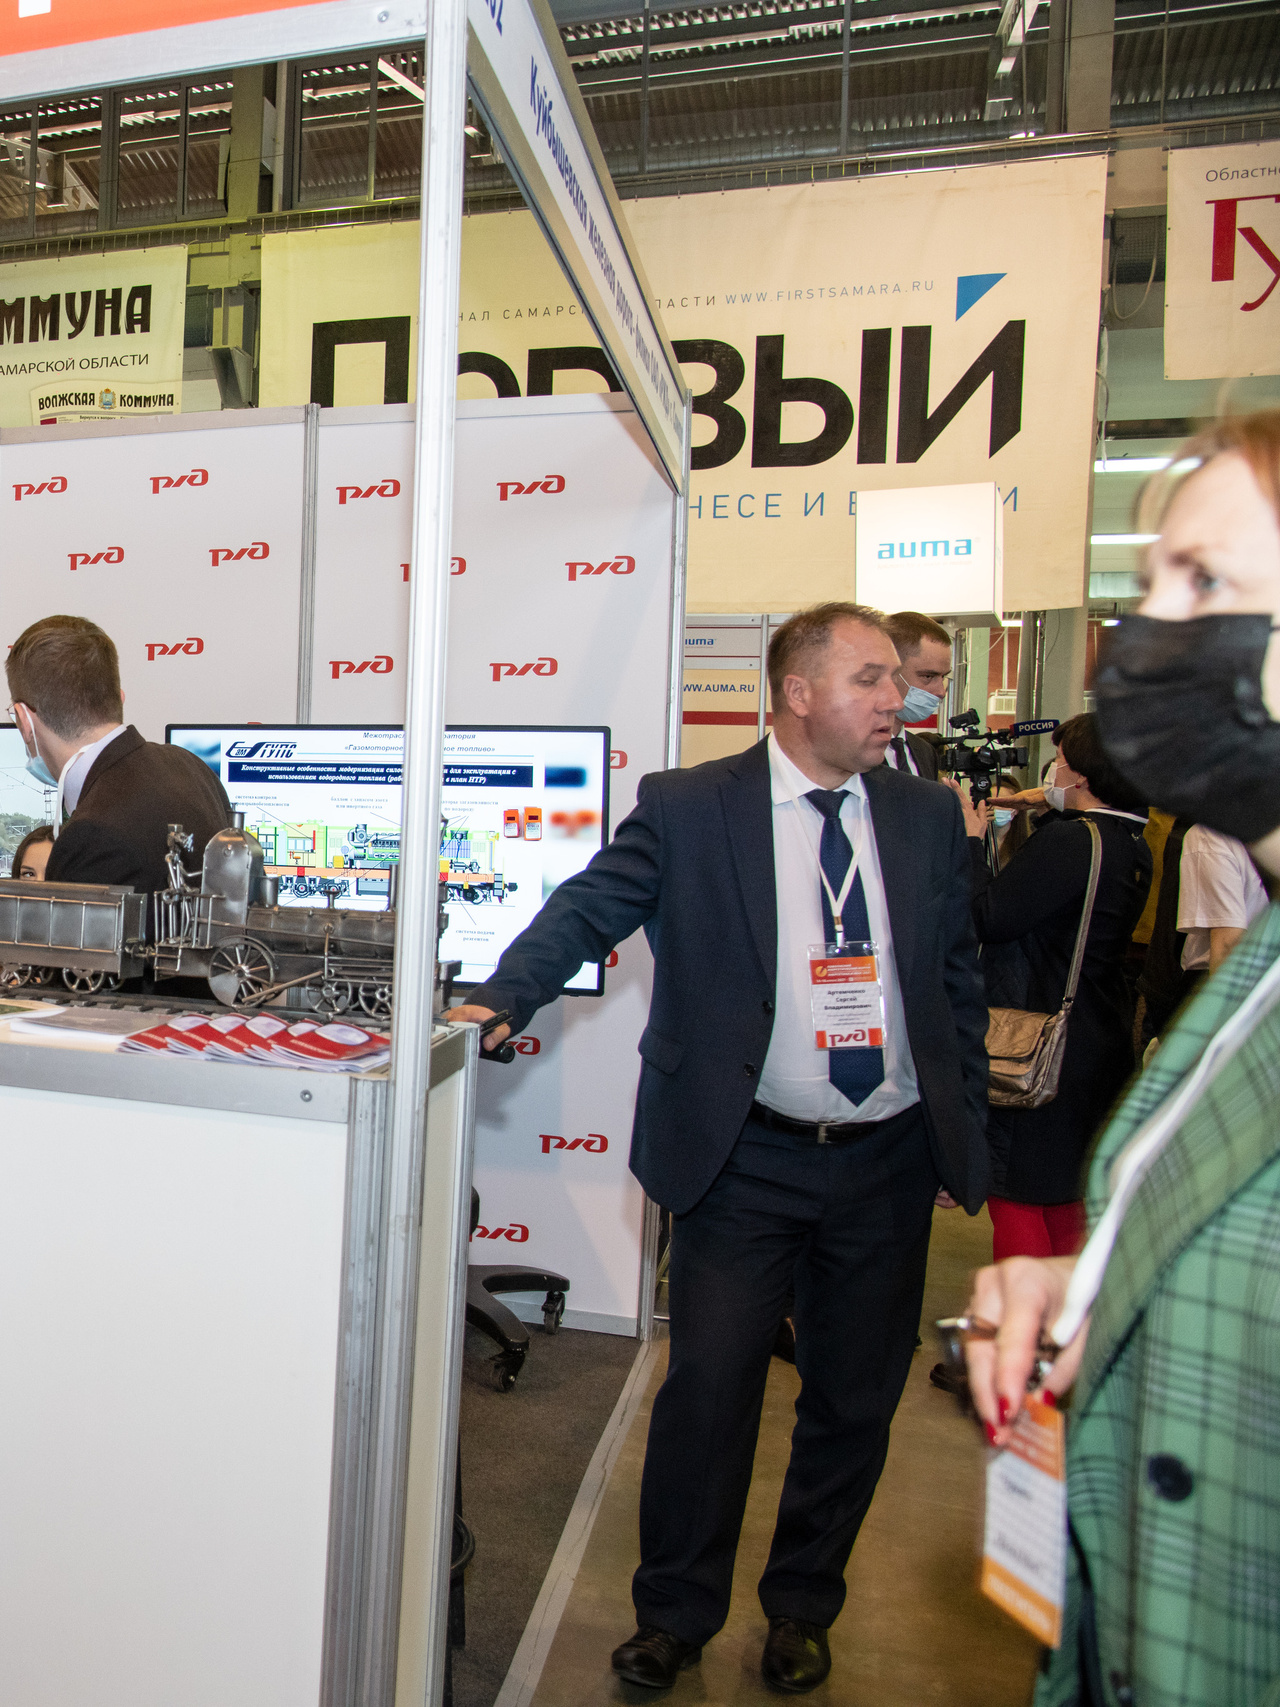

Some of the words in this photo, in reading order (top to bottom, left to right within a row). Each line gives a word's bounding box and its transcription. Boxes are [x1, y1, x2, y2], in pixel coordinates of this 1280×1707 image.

[530, 54, 587, 232] Куйбышевская
[1206, 165, 1280, 183] Областн
[725, 280, 935, 305] WWW.FIRSTSAMARA.RU
[503, 304, 584, 320] САМАРС
[655, 295, 716, 310] ЛАСТИ
[79, 353, 149, 370] ОБЛАСТИ
[38, 392, 96, 411] ВОЛЖСКАЯ
[119, 393, 174, 408] КОММУНА
[877, 538, 972, 560] auma
[683, 683, 755, 693] WW.AUMA.RU
[1018, 721, 1054, 732] РОССИЯ
[363, 732, 404, 740] Межотрас
